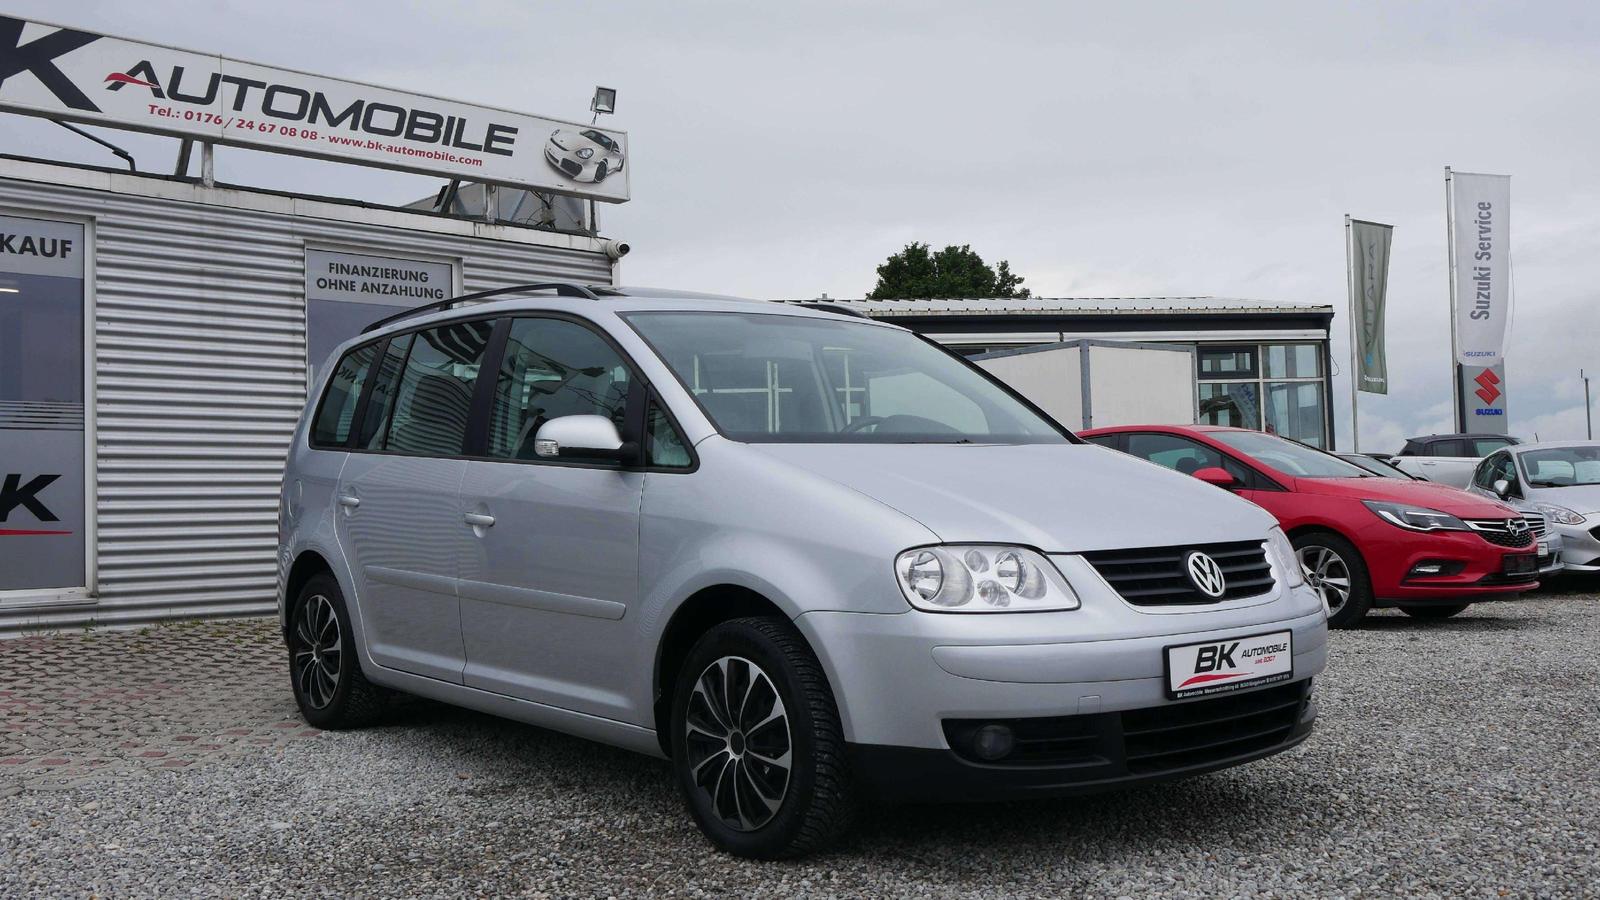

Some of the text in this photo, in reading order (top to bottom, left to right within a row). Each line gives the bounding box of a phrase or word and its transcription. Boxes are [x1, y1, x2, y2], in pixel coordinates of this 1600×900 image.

[104, 60, 519, 157] AUTOMOBILE
[148, 104, 180, 119] Tel.:
[184, 110, 223, 125] 0176
[236, 119, 255, 130] 24
[258, 122, 276, 133] 67
[280, 126, 297, 137] 08
[300, 129, 318, 140] 08
[328, 135, 483, 167] www.bk-automobile.com
[0, 233, 72, 258] KAUF
[1470, 202, 1492, 320] Suzuki Service
[317, 278, 444, 299] OHNE ANZAHLUNG
[329, 262, 429, 282] FINANZIERUNG
[0, 474, 63, 522] K
[1194, 642, 1288, 674] BK AUTOMOBILE
